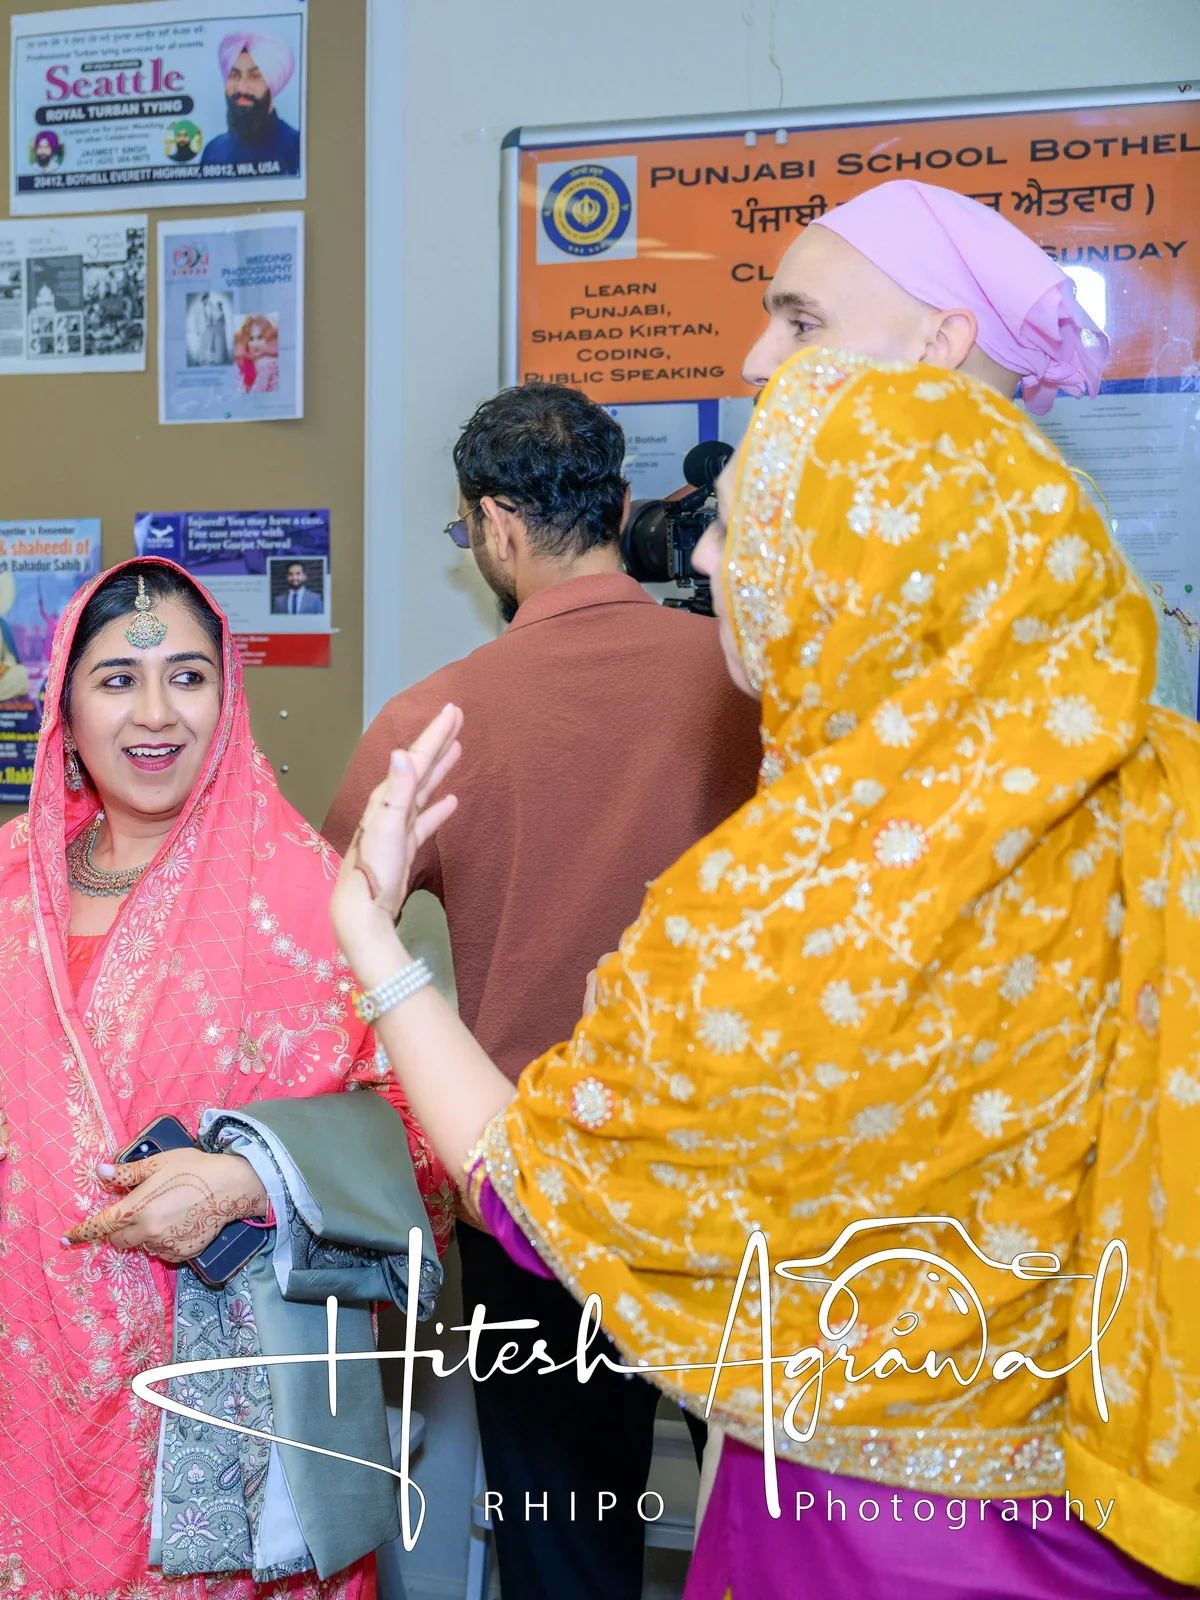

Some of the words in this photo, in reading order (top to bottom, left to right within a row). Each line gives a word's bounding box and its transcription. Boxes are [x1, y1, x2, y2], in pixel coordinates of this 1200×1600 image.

[45, 57, 185, 101] Seattle
[46, 108, 86, 123] ROYAL
[88, 103, 139, 118] TURBAN
[143, 99, 183, 114] TYING
[836, 146, 1008, 176] SCHOOL
[66, 174, 109, 187] BOTHELL
[110, 169, 152, 183] EVERETT
[258, 160, 281, 174] USA
[86, 233, 100, 259] 3
[1041, 240, 1188, 264] SUNDAY
[245, 253, 293, 265] WEDDING
[221, 264, 293, 278] PHOTOGRAPHY
[226, 275, 293, 288] VIDEOGRAPHY
[584, 282, 657, 298] LEARN
[570, 304, 672, 320] PUNJABI,
[531, 327, 623, 343] SHABAD
[629, 323, 720, 339] KIRTAN,
[576, 347, 672, 363] CODING,
[610, 365, 725, 382] SPEAKING
[634, 435, 668, 445] Bothell
[187, 516, 226, 529] Injured?
[227, 516, 242, 527] You
[246, 517, 267, 529] may
[269, 514, 291, 526] have
[293, 517, 299, 525] a
[38, 526, 75, 536] Remember
[187, 527, 208, 539] Free
[209, 529, 228, 538] case
[229, 528, 260, 538] review
[261, 527, 285, 538] with
[0, 539, 8, 557] &
[11, 538, 72, 556] shaheedi
[76, 537, 91, 556] of
[187, 539, 222, 552] Lawyer
[11, 558, 52, 572] Bahadur
[54, 557, 83, 572] Sahib
